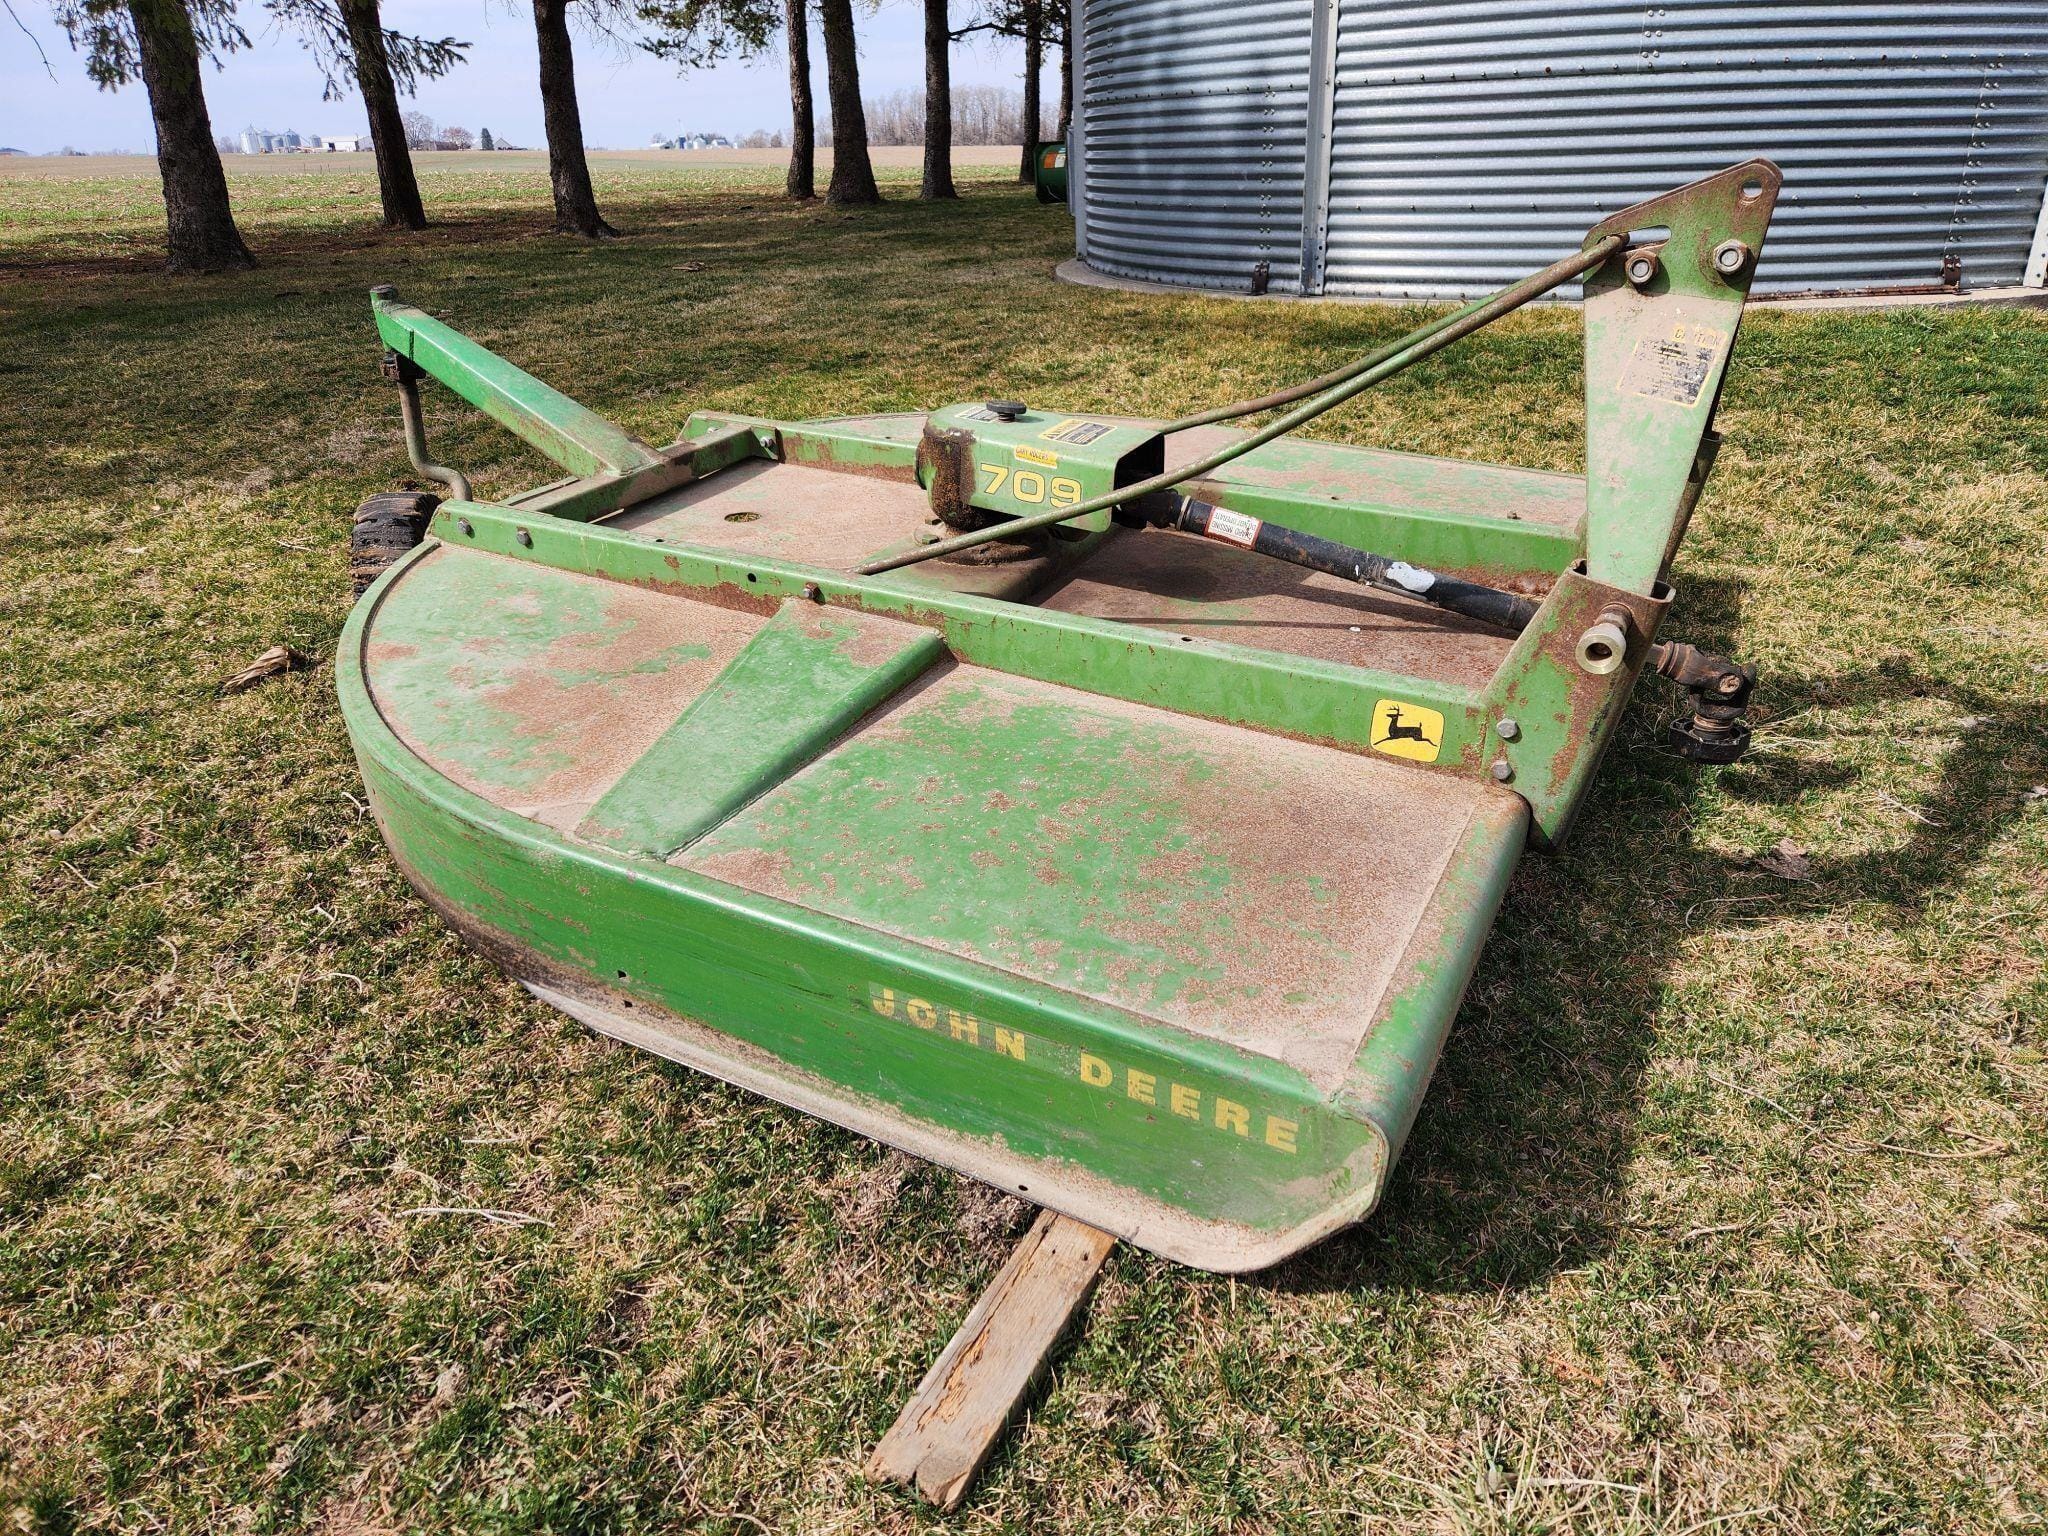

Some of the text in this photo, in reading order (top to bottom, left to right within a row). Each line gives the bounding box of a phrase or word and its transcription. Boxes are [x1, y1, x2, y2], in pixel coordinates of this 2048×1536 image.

[980, 463, 1082, 508] 709
[872, 988, 1299, 1154] JOHN DEERE
